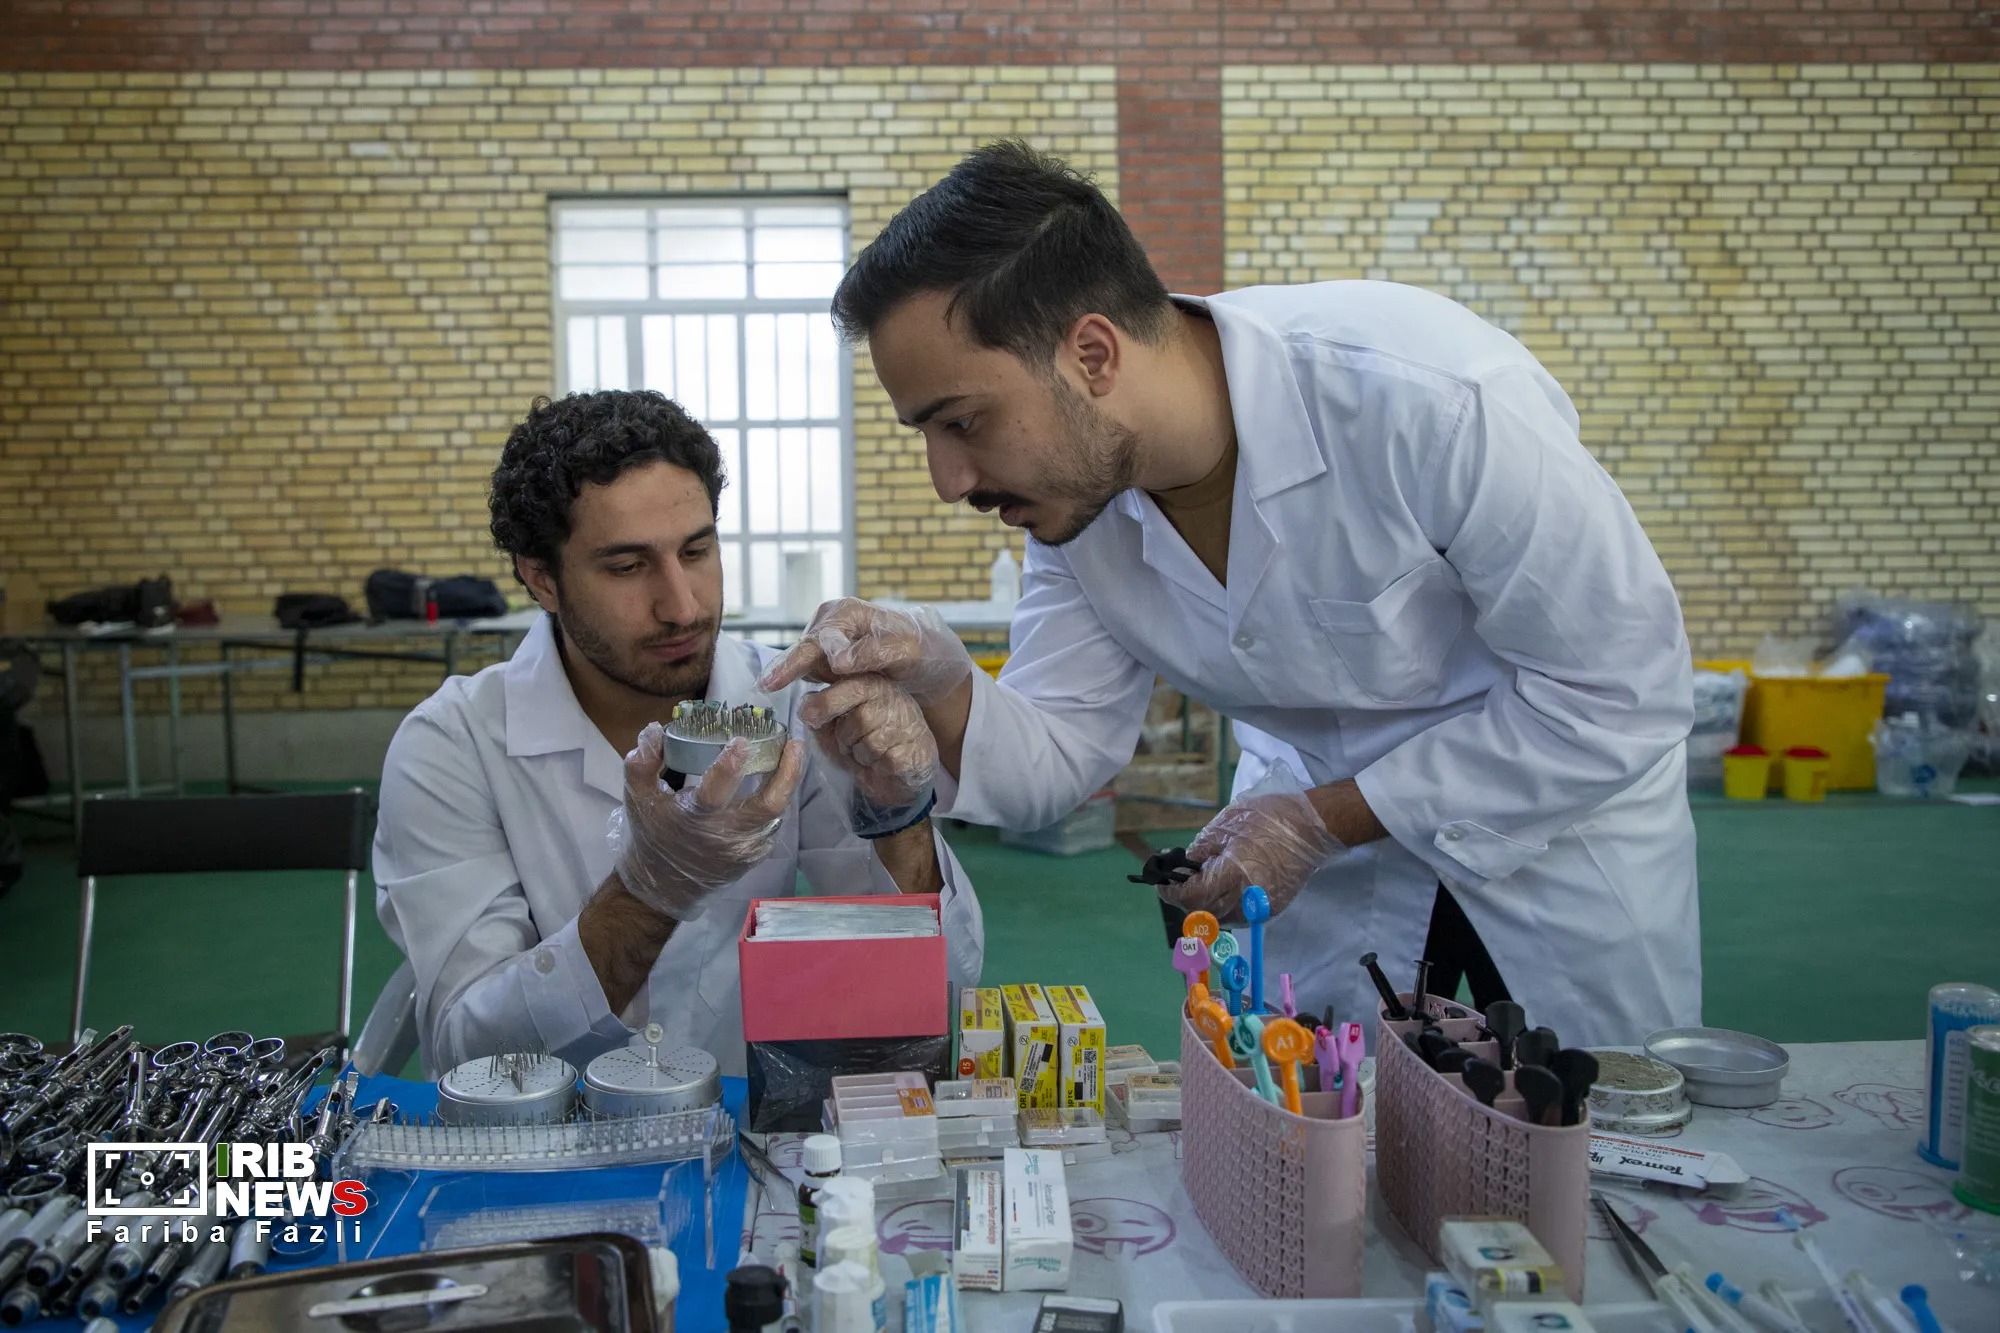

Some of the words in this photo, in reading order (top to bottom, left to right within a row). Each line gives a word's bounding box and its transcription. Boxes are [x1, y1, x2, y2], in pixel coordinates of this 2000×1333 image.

[1193, 924, 1210, 937] AO2
[1182, 943, 1197, 951] OA1
[1275, 1035, 1295, 1052] A1
[962, 1061, 972, 1072] 15
[1619, 1156, 1684, 1175] Temrex
